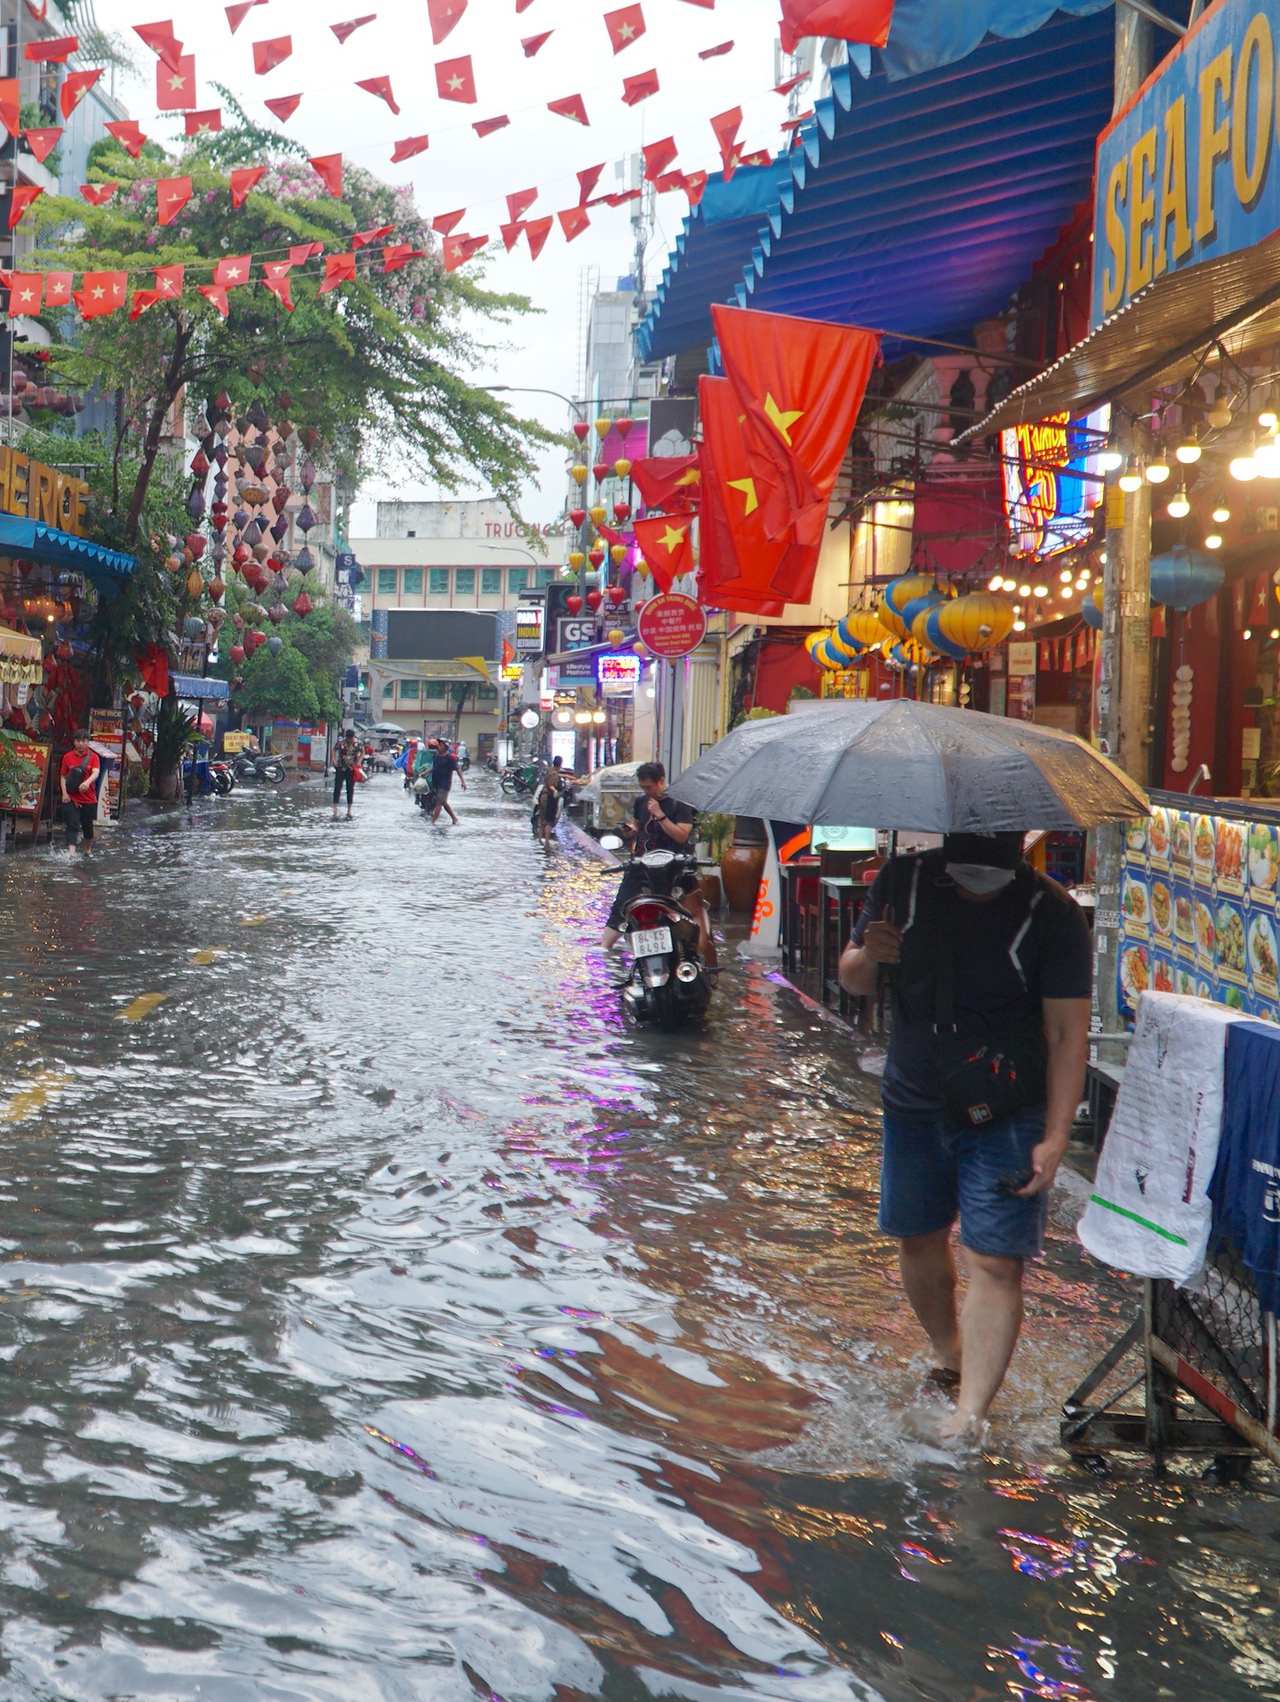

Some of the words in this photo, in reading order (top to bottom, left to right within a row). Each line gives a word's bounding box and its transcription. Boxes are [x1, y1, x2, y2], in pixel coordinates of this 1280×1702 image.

[1101, 11, 1280, 305] SEAFO
[26, 458, 89, 538] RICE
[517, 627, 540, 638] INDIAN
[565, 623, 595, 641] GS
[640, 942, 667, 955] 8494
